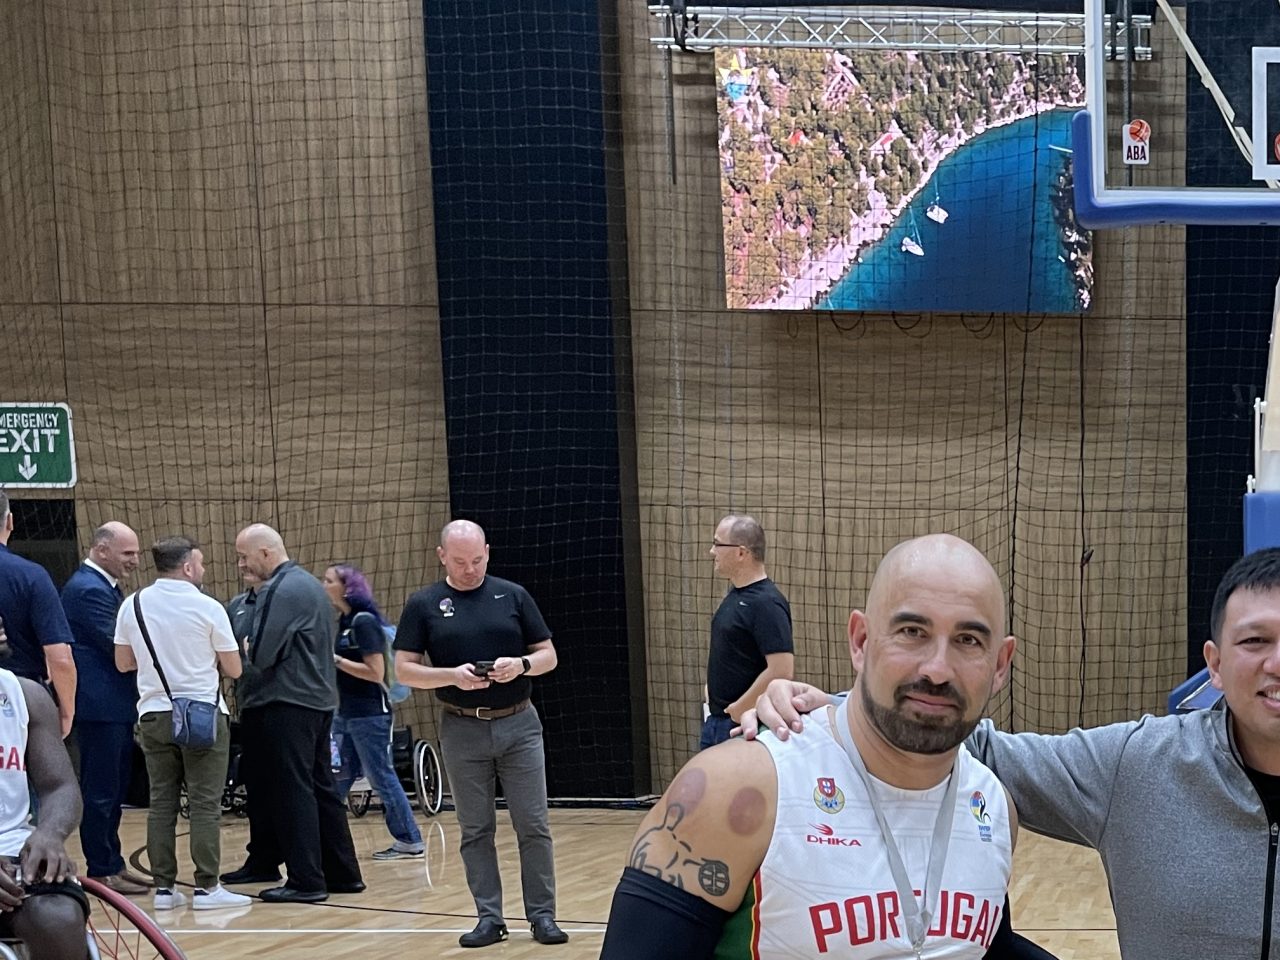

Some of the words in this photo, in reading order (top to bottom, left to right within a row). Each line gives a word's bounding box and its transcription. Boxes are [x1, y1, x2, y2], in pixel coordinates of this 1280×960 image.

[1127, 145, 1147, 161] ABA
[0, 429, 60, 453] EXIT
[807, 834, 862, 847] DHIKA
[809, 890, 1000, 953] PORUGAL
